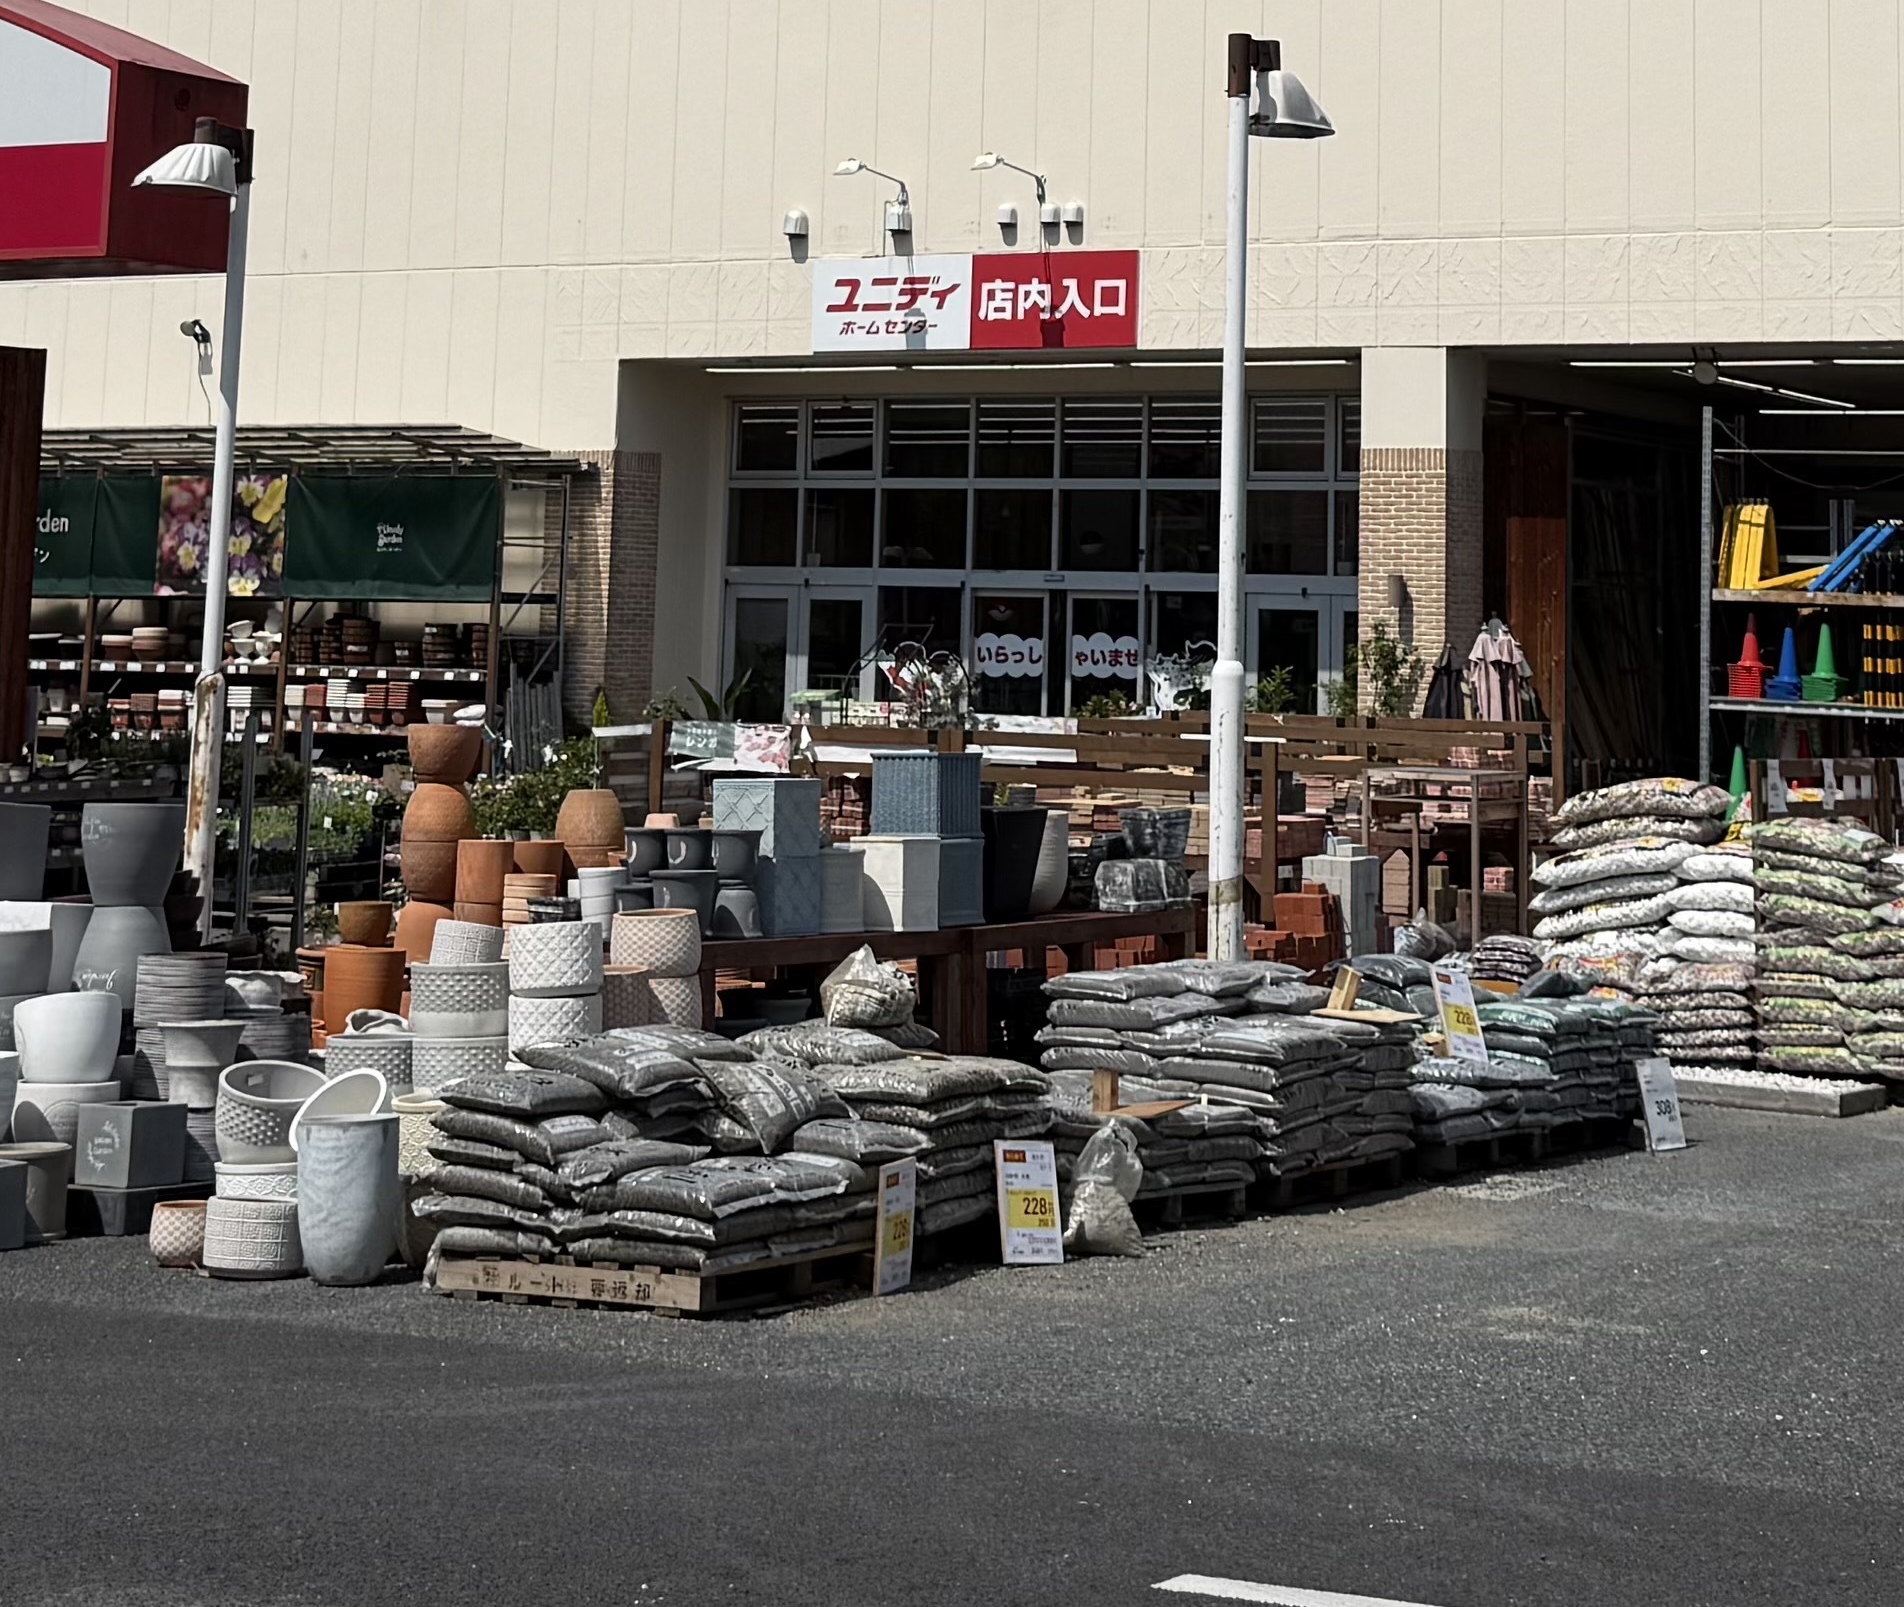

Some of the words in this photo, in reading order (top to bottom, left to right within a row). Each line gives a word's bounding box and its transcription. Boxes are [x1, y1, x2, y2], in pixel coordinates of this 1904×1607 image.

[825, 275, 961, 314] ユニディ
[978, 277, 1127, 321] 店内入口
[977, 645, 1043, 665] いらっし
[1022, 1196, 1048, 1216] 228
